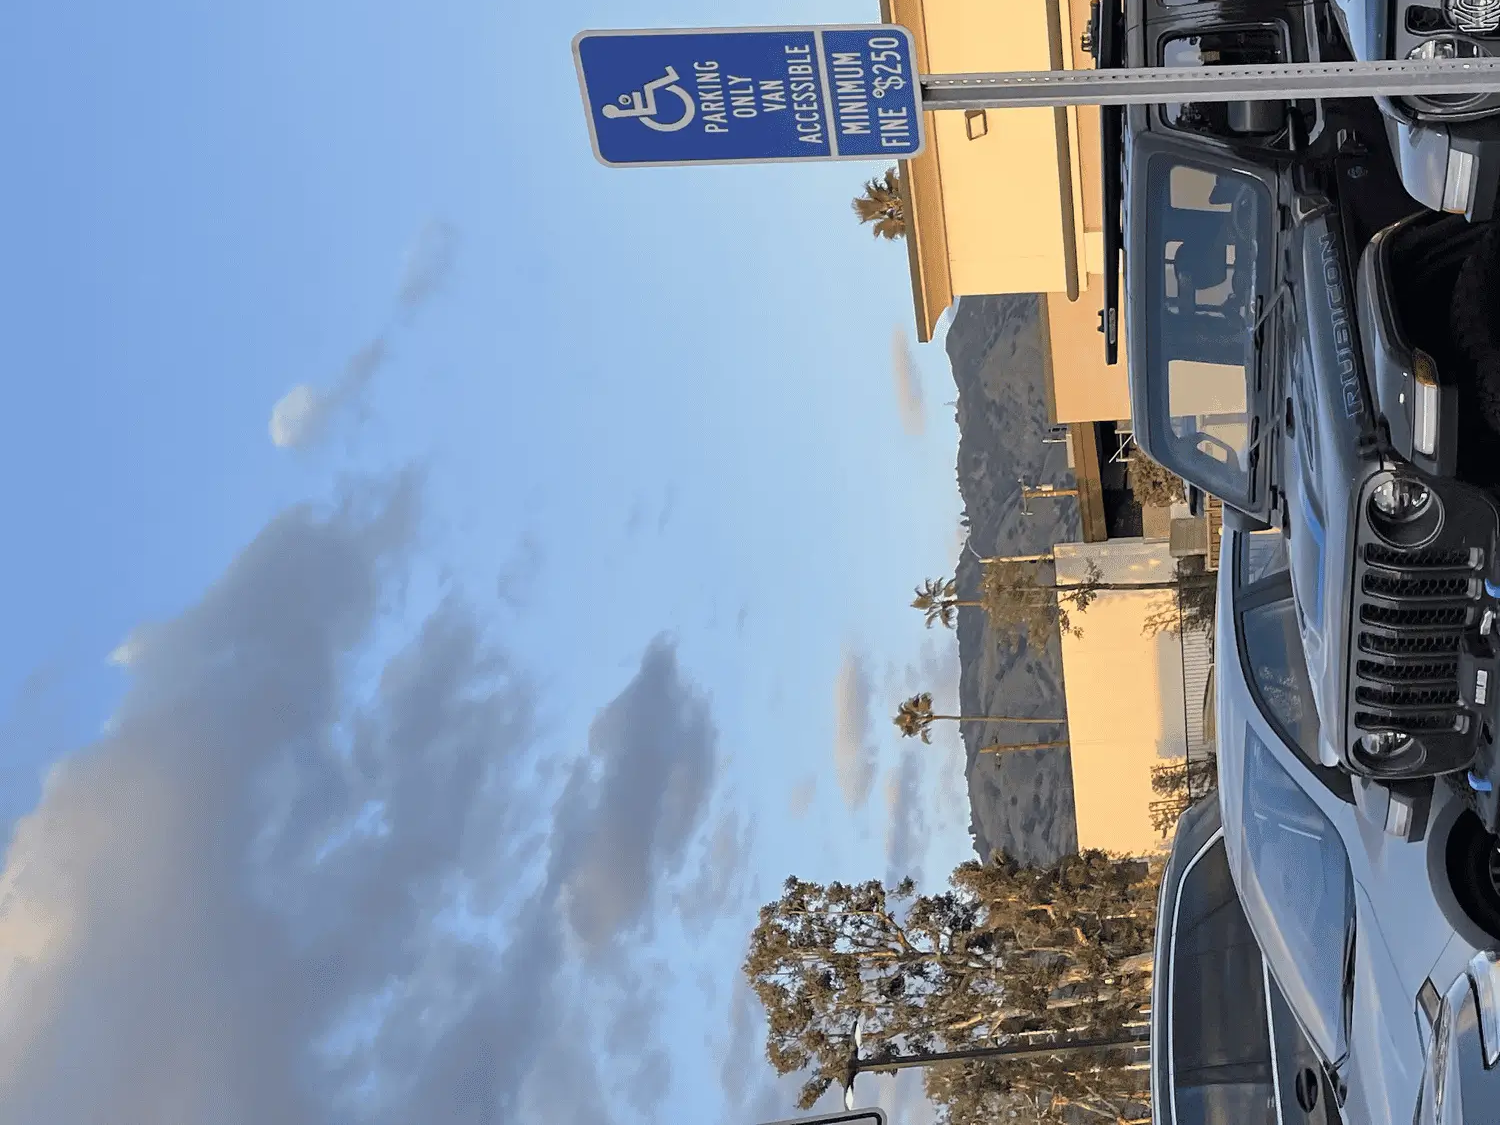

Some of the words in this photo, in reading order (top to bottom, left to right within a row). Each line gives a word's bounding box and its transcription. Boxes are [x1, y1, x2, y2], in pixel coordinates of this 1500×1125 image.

[785, 44, 823, 143] ACCESSIBLE
[832, 52, 871, 134] MINIMUM
[869, 37, 906, 90] $250
[694, 60, 728, 132] PARKING
[727, 75, 757, 117] ONLY
[759, 80, 786, 112] VAN
[877, 106, 911, 147] FINE
[1318, 231, 1364, 418] RUBICON
